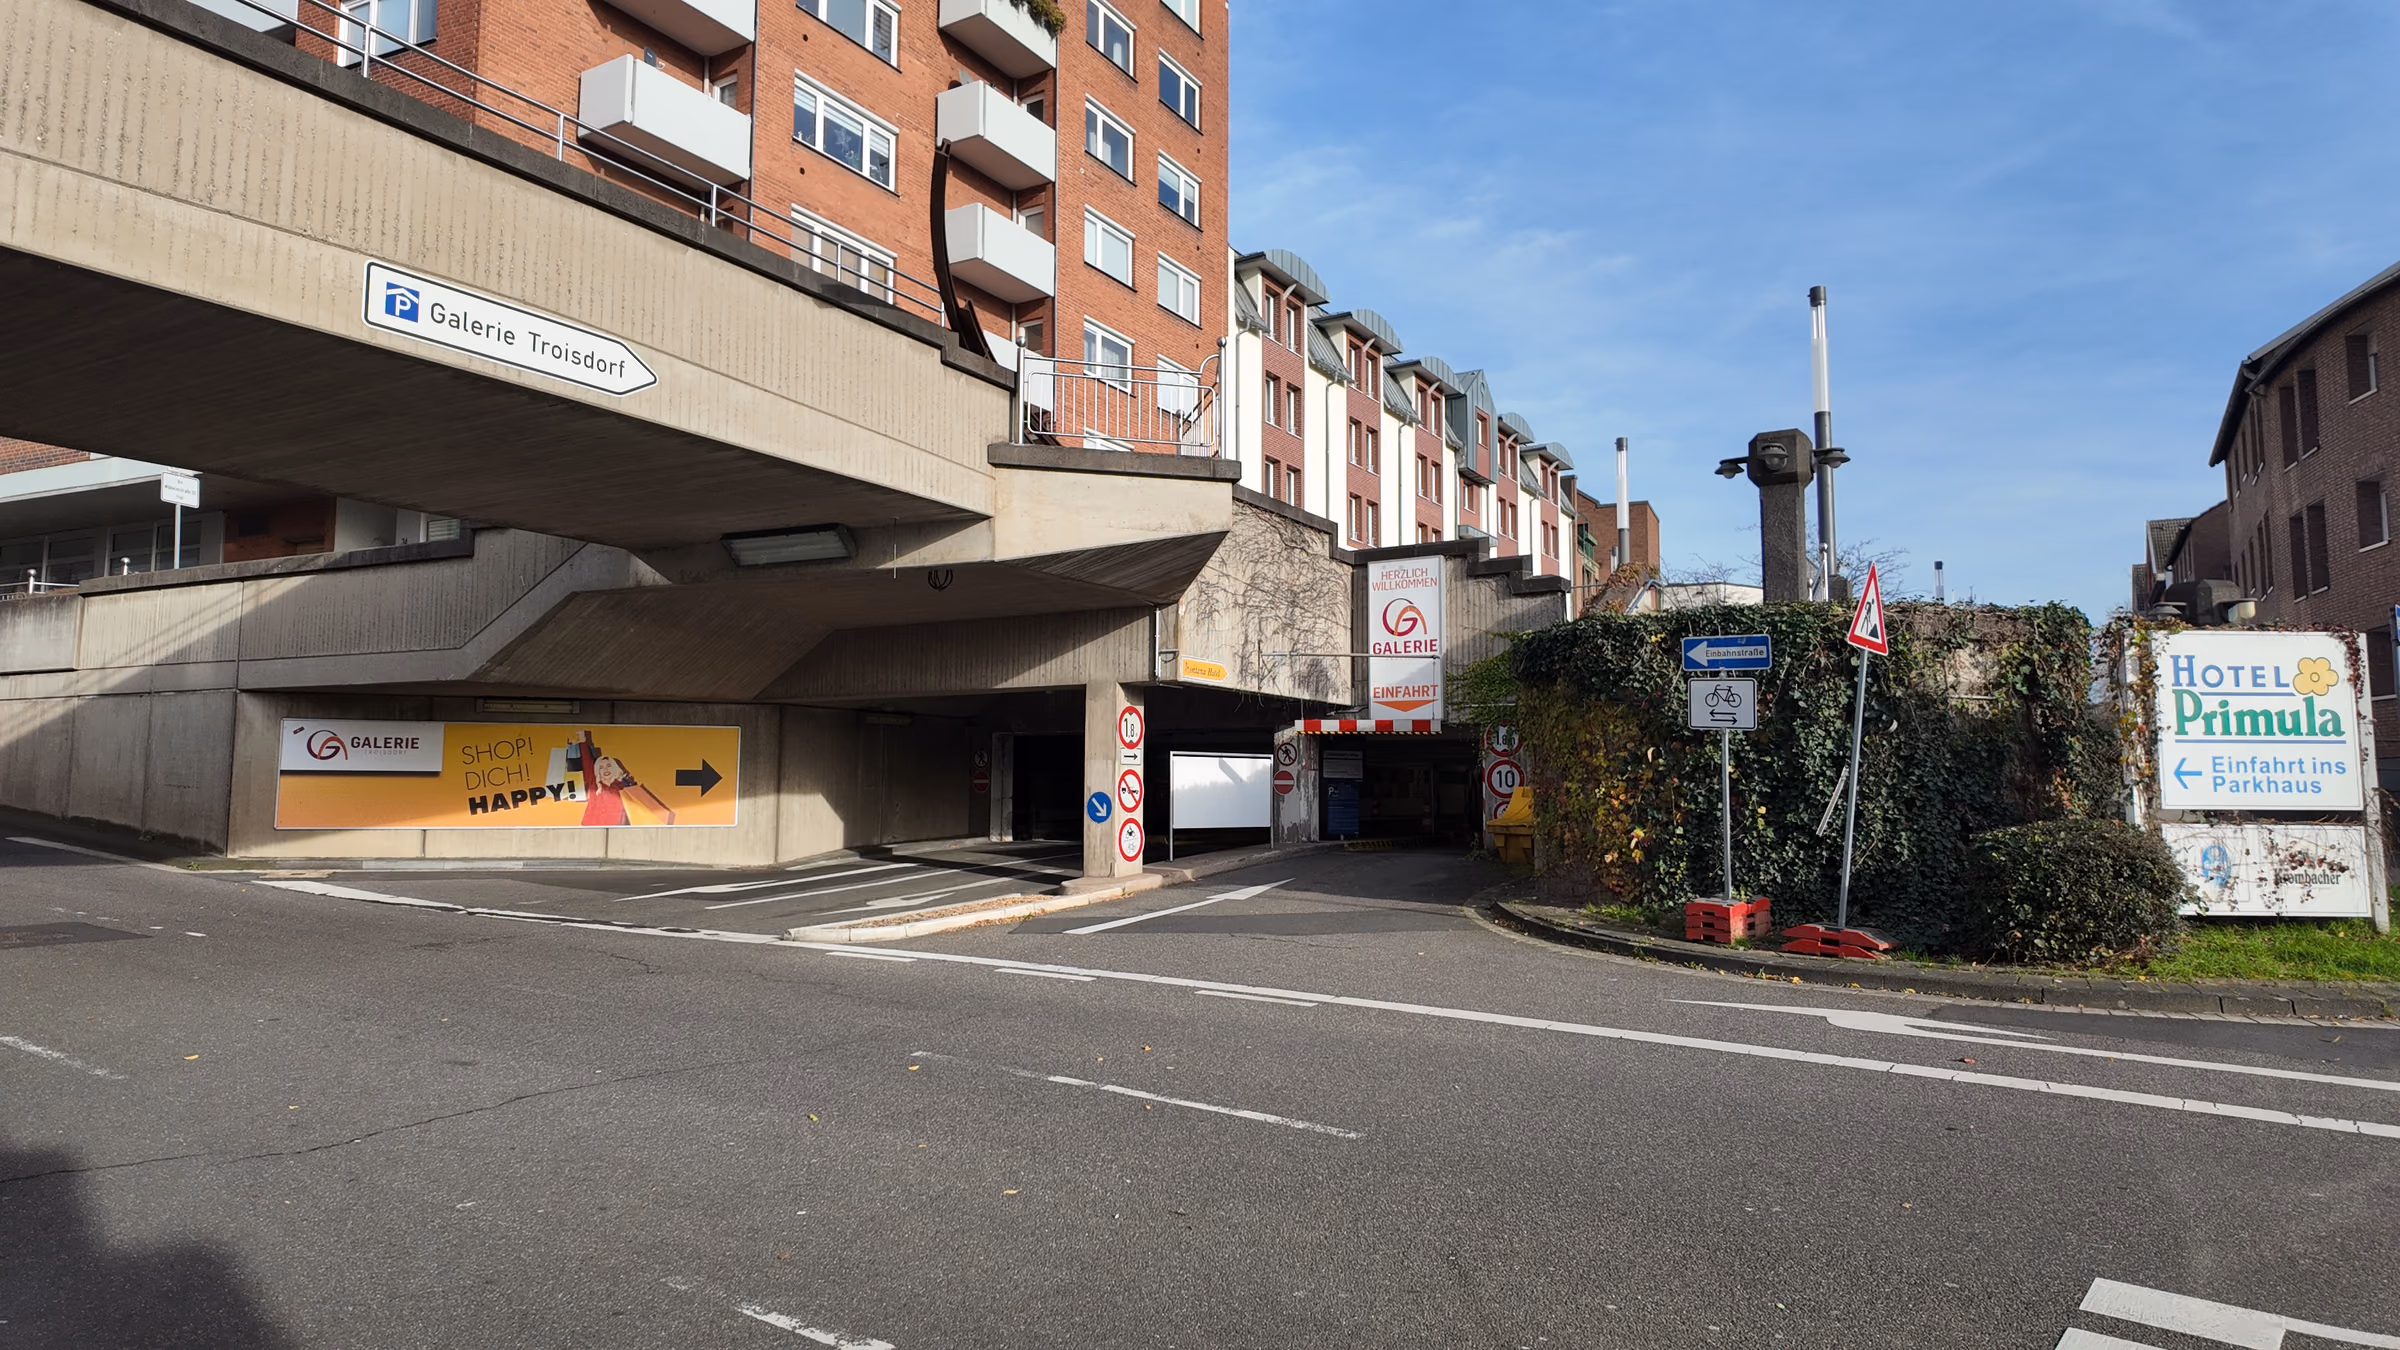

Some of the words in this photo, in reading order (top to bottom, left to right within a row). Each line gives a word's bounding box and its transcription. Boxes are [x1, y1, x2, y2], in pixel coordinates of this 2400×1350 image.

[429, 302, 517, 346] Galerie
[527, 331, 626, 379] Troisdorf
[1381, 567, 1429, 581] HERZLICH
[1371, 576, 1438, 592] WILLKOMMEN
[1372, 638, 1438, 655] GALERIE
[1705, 648, 1765, 658] Einbahnstraße
[2170, 654, 2291, 689] HOTEL
[1373, 684, 1439, 699] EINFAHRT
[2172, 688, 2346, 738] Primula
[350, 736, 420, 750] GALERIE
[461, 736, 534, 765] SHOP!
[2211, 756, 2305, 775] Einfahrt
[2312, 757, 2347, 775] ins
[464, 762, 531, 791] DICH!
[1496, 769, 1516, 788] 10
[2212, 776, 2322, 794] Parkhaus
[468, 780, 577, 816] HAPPY!
